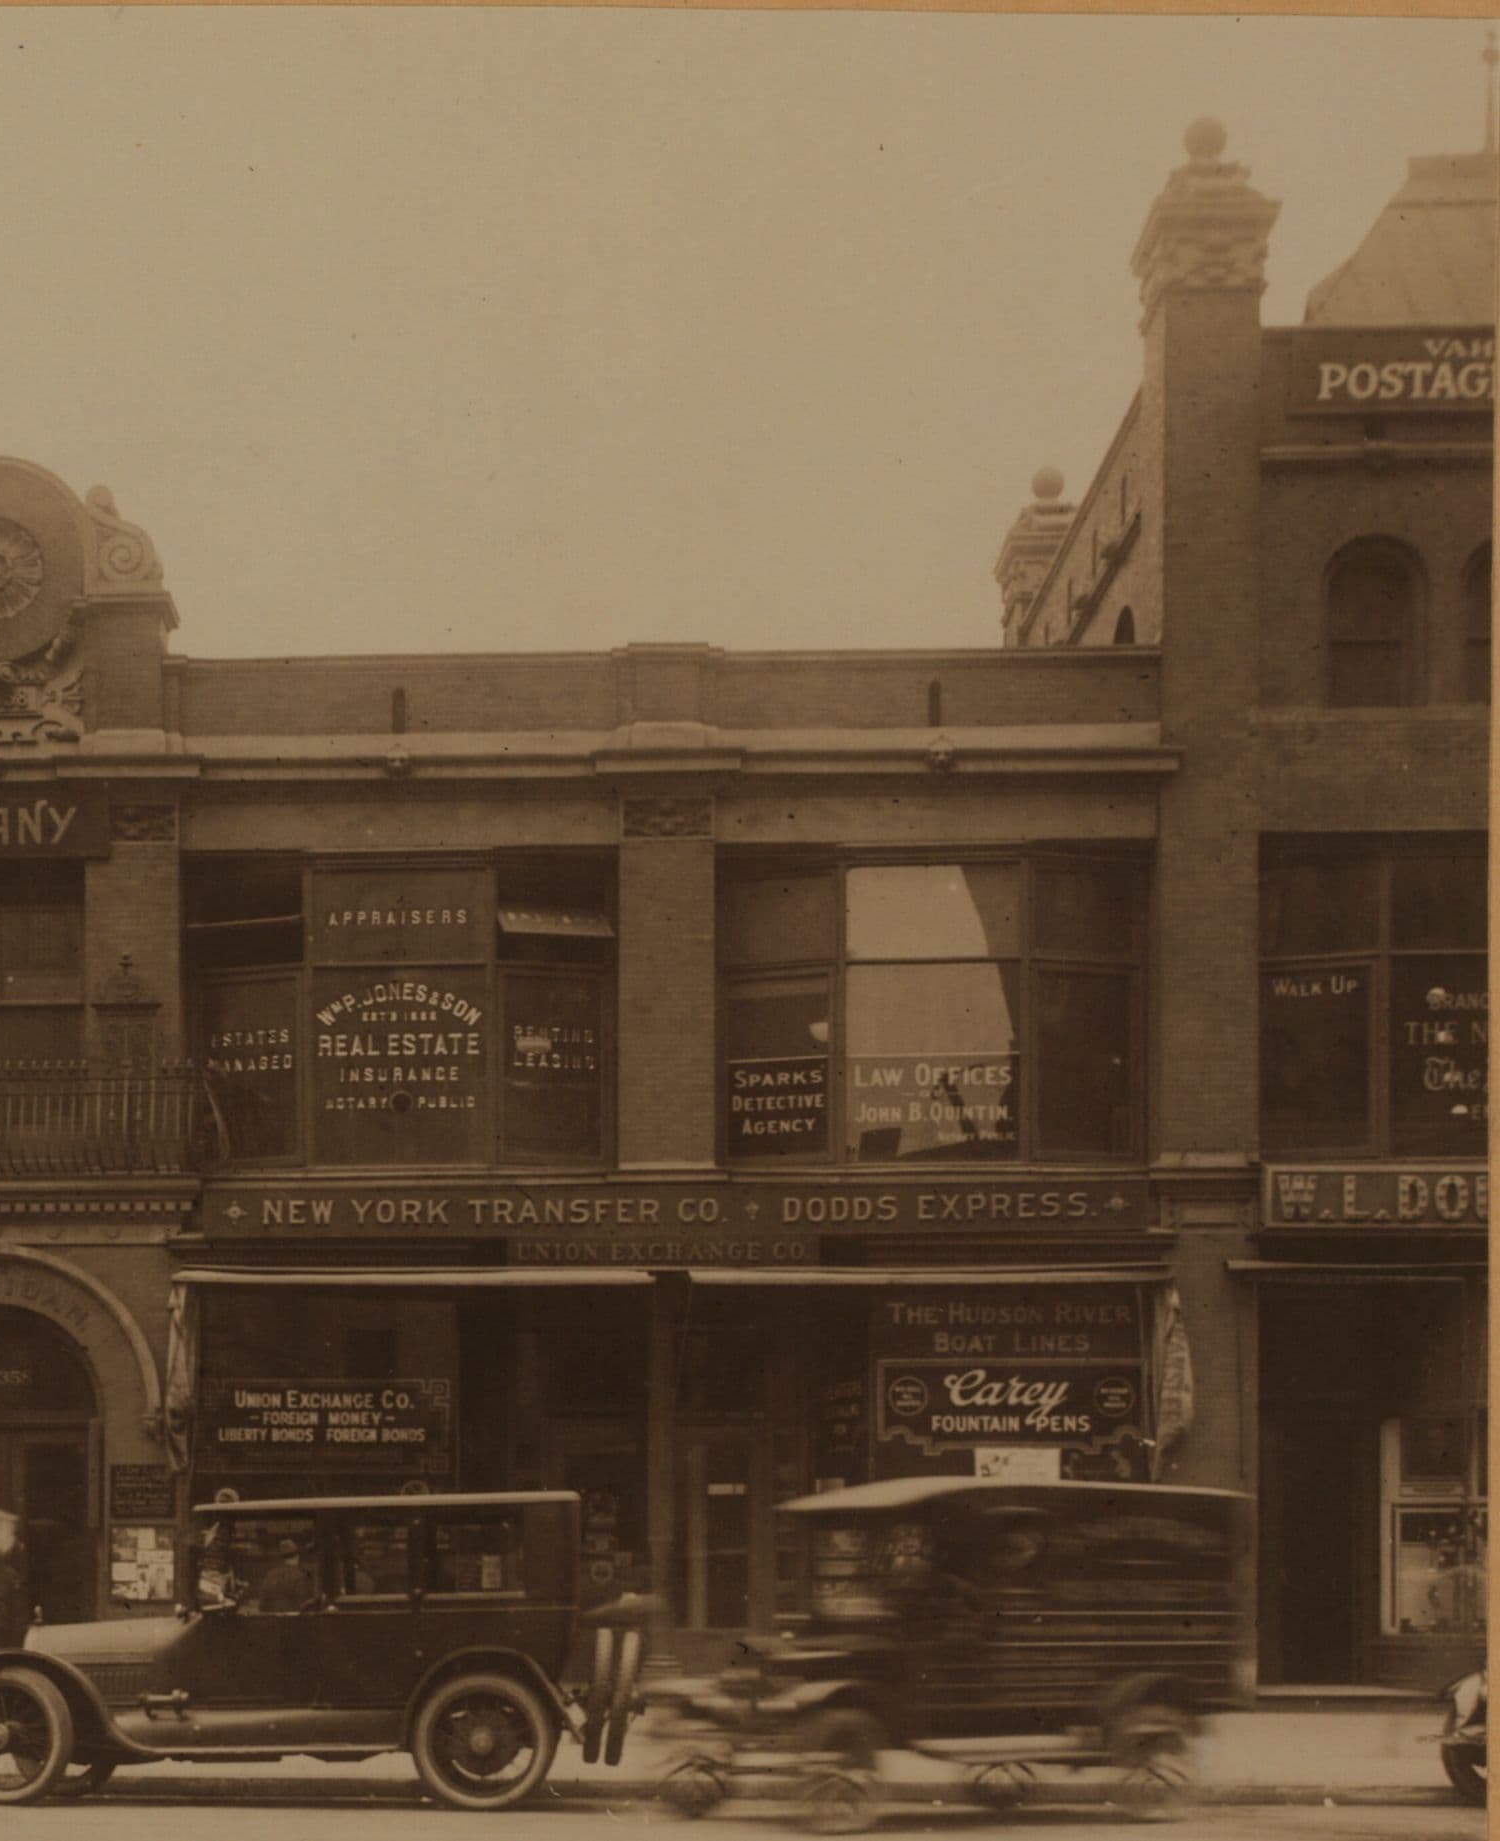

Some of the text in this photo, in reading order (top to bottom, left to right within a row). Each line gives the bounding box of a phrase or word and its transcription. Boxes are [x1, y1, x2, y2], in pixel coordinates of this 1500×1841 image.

[1316, 362, 1493, 401] POSTAG
[327, 908, 469, 928] APPRAISERS
[1272, 975, 1358, 998] WALK UP
[316, 1033, 481, 1058] REAL ESTATE
[339, 1066, 460, 1083] INSURANCE
[854, 1063, 1012, 1087] LAW OFFICES
[416, 1096, 476, 1109] PUBLIC
[731, 1093, 825, 1112] DETECTIVE
[856, 1102, 901, 1123] JOHN
[742, 1117, 816, 1136] AGENCY
[260, 1191, 1099, 1225] NEW YORK TRANSFER CO. DODDS EXPRESS.
[516, 1242, 600, 1262] UNION
[610, 1241, 761, 1262] EXCHANGE
[887, 1301, 1132, 1326] THE HUDSON RIVER
[932, 1331, 1092, 1353] BOAT LINES
[235, 1390, 416, 1409] UNION EXCHANGE CO.
[943, 1369, 1071, 1426] Carey
[262, 1410, 383, 1426] FOREIGN MONEY
[931, 1415, 1092, 1433] FOUNTAIN PENS
[218, 1427, 426, 1442] LIBERTY BONDS FOREIGN BONDS
